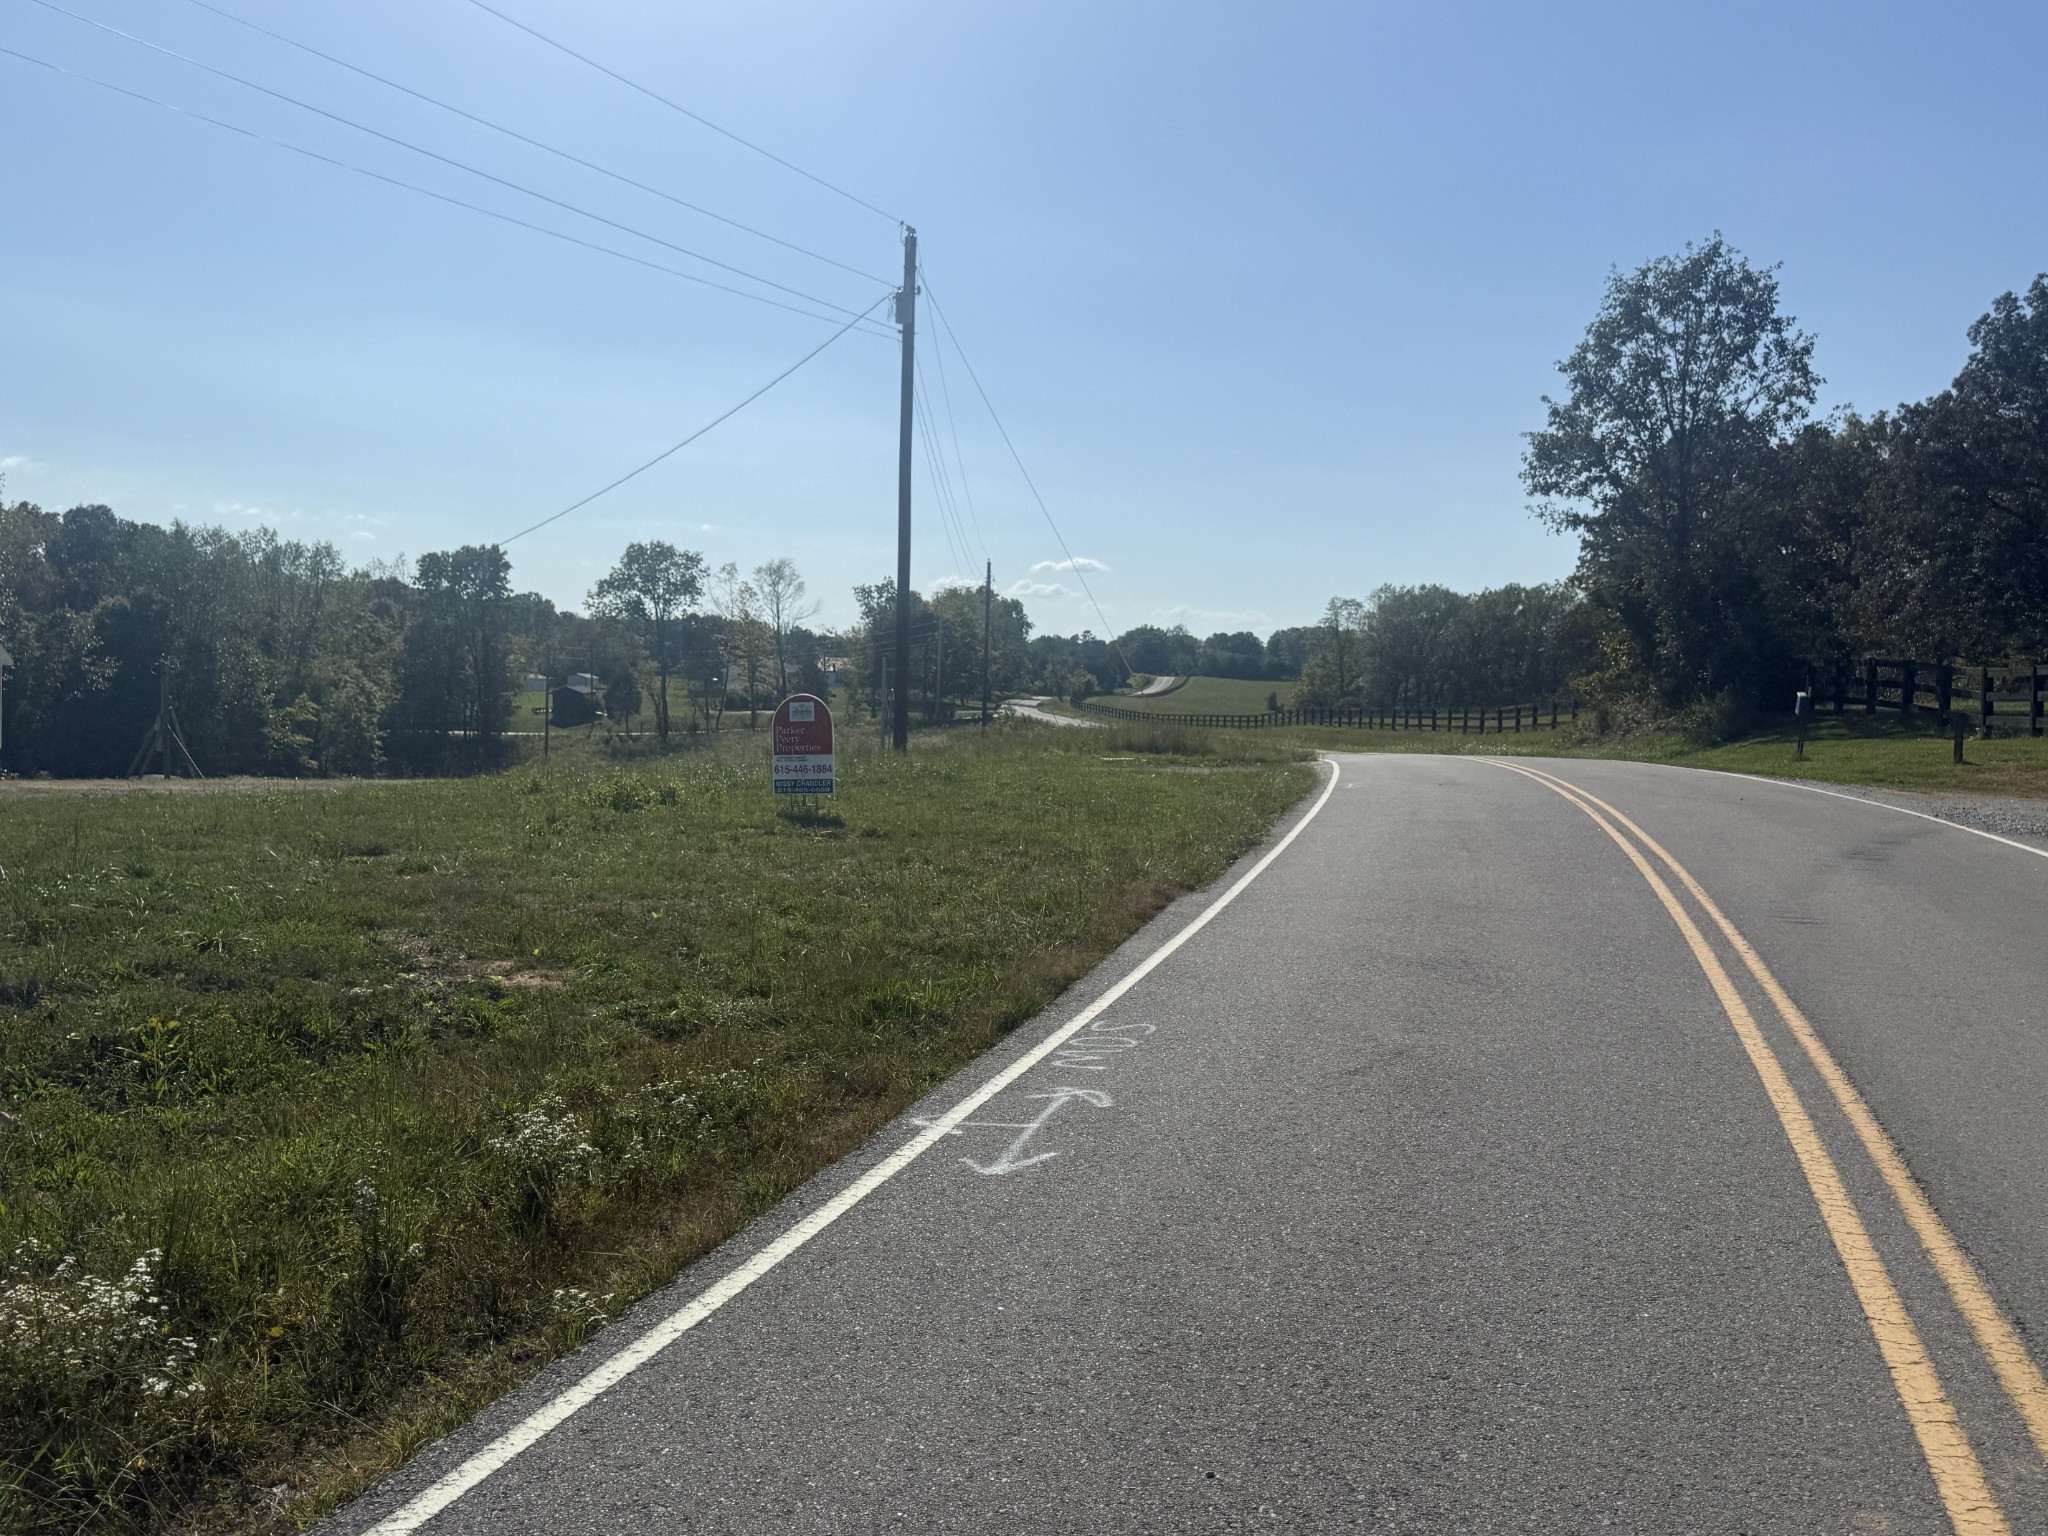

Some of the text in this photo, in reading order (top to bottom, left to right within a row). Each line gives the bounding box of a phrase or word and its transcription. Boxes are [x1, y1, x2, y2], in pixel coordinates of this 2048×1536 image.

[776, 726, 805, 735] Parker
[776, 735, 801, 744] Peery
[776, 742, 821, 754] Properties
[774, 764, 833, 774] 615-446-1884
[796, 779, 832, 787] CHANDLER
